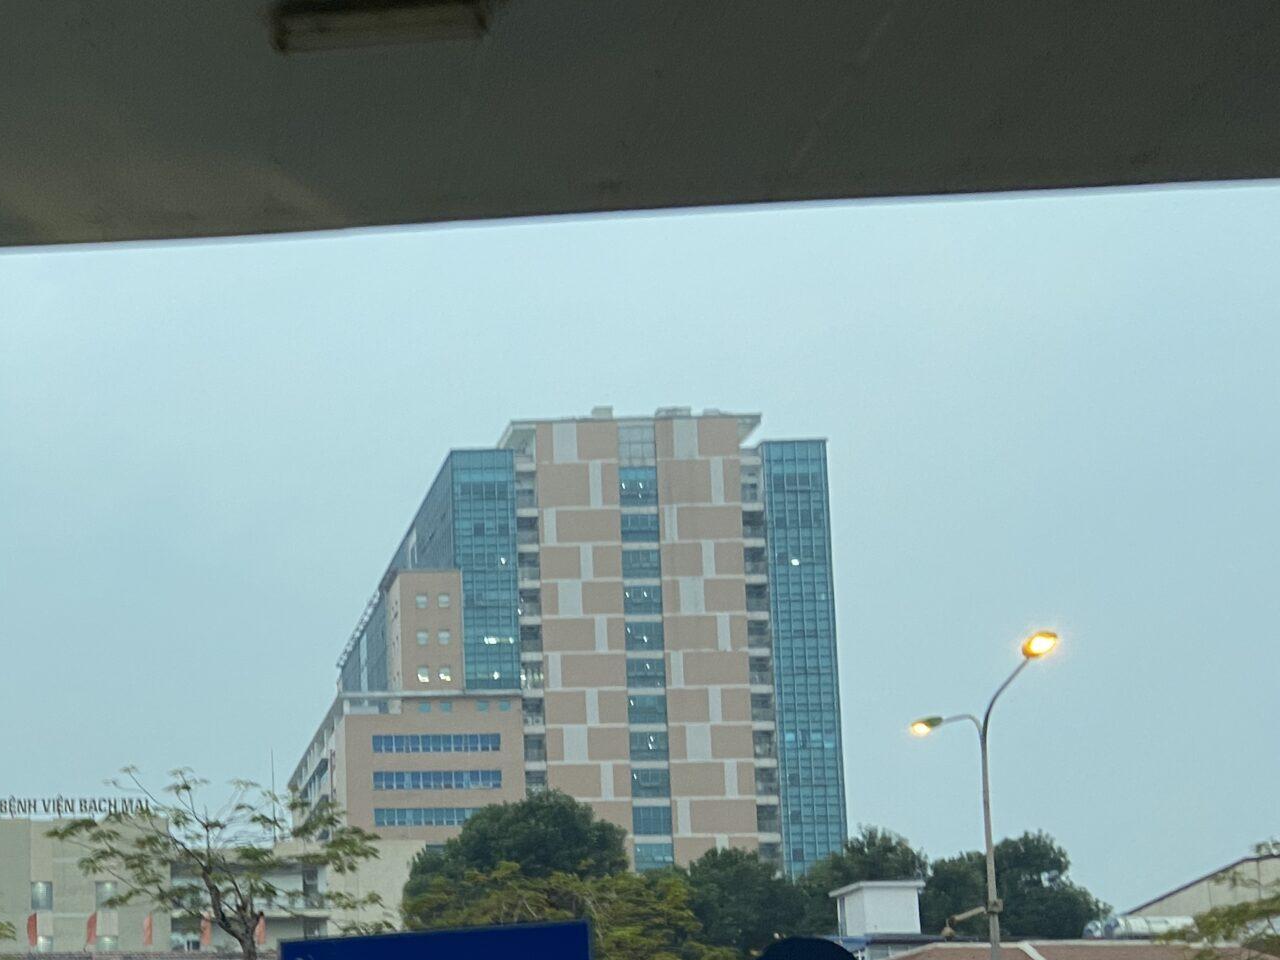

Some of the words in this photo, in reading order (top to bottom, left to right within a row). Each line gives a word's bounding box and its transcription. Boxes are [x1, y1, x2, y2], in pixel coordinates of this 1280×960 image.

[0, 794, 37, 819] BỆNH
[41, 794, 75, 818] VIỆN
[79, 798, 117, 818] BẠCH
